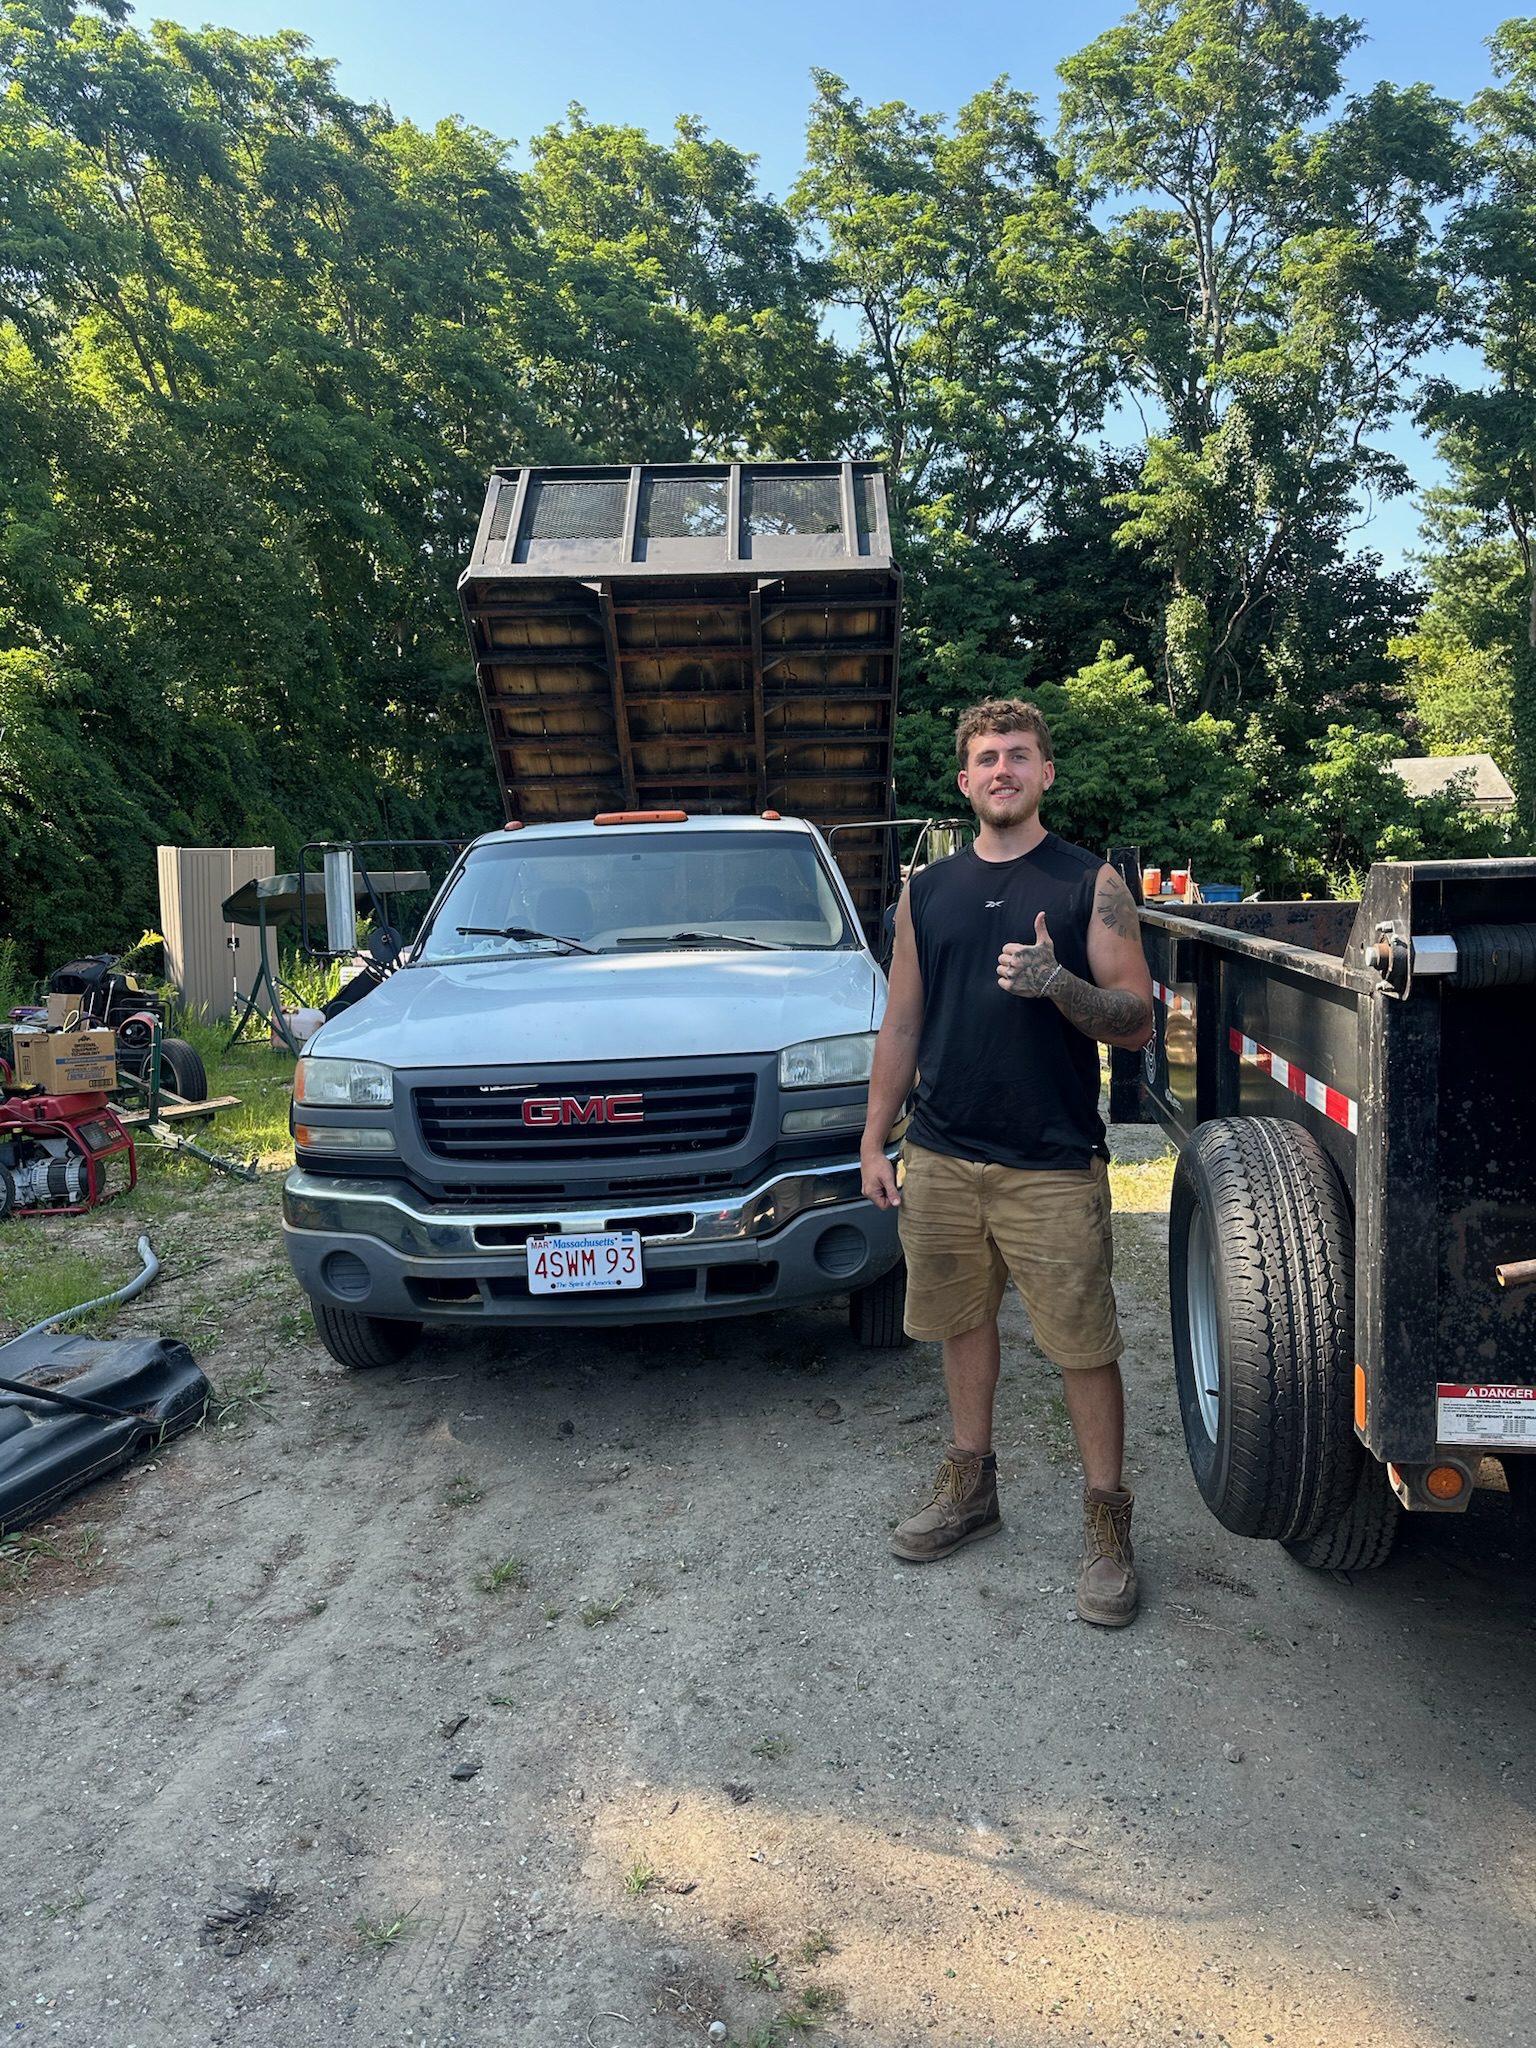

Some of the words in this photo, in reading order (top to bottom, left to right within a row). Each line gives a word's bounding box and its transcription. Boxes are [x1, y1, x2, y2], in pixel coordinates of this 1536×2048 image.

[522, 1093, 644, 1127] GMC
[552, 1237, 615, 1249] Massachusetts
[535, 1248, 596, 1279] 4SWM
[606, 1247, 635, 1274] 93
[569, 1281, 584, 1289] Spirit
[592, 1279, 616, 1287] America
[1479, 1387, 1534, 1399] DANGER
